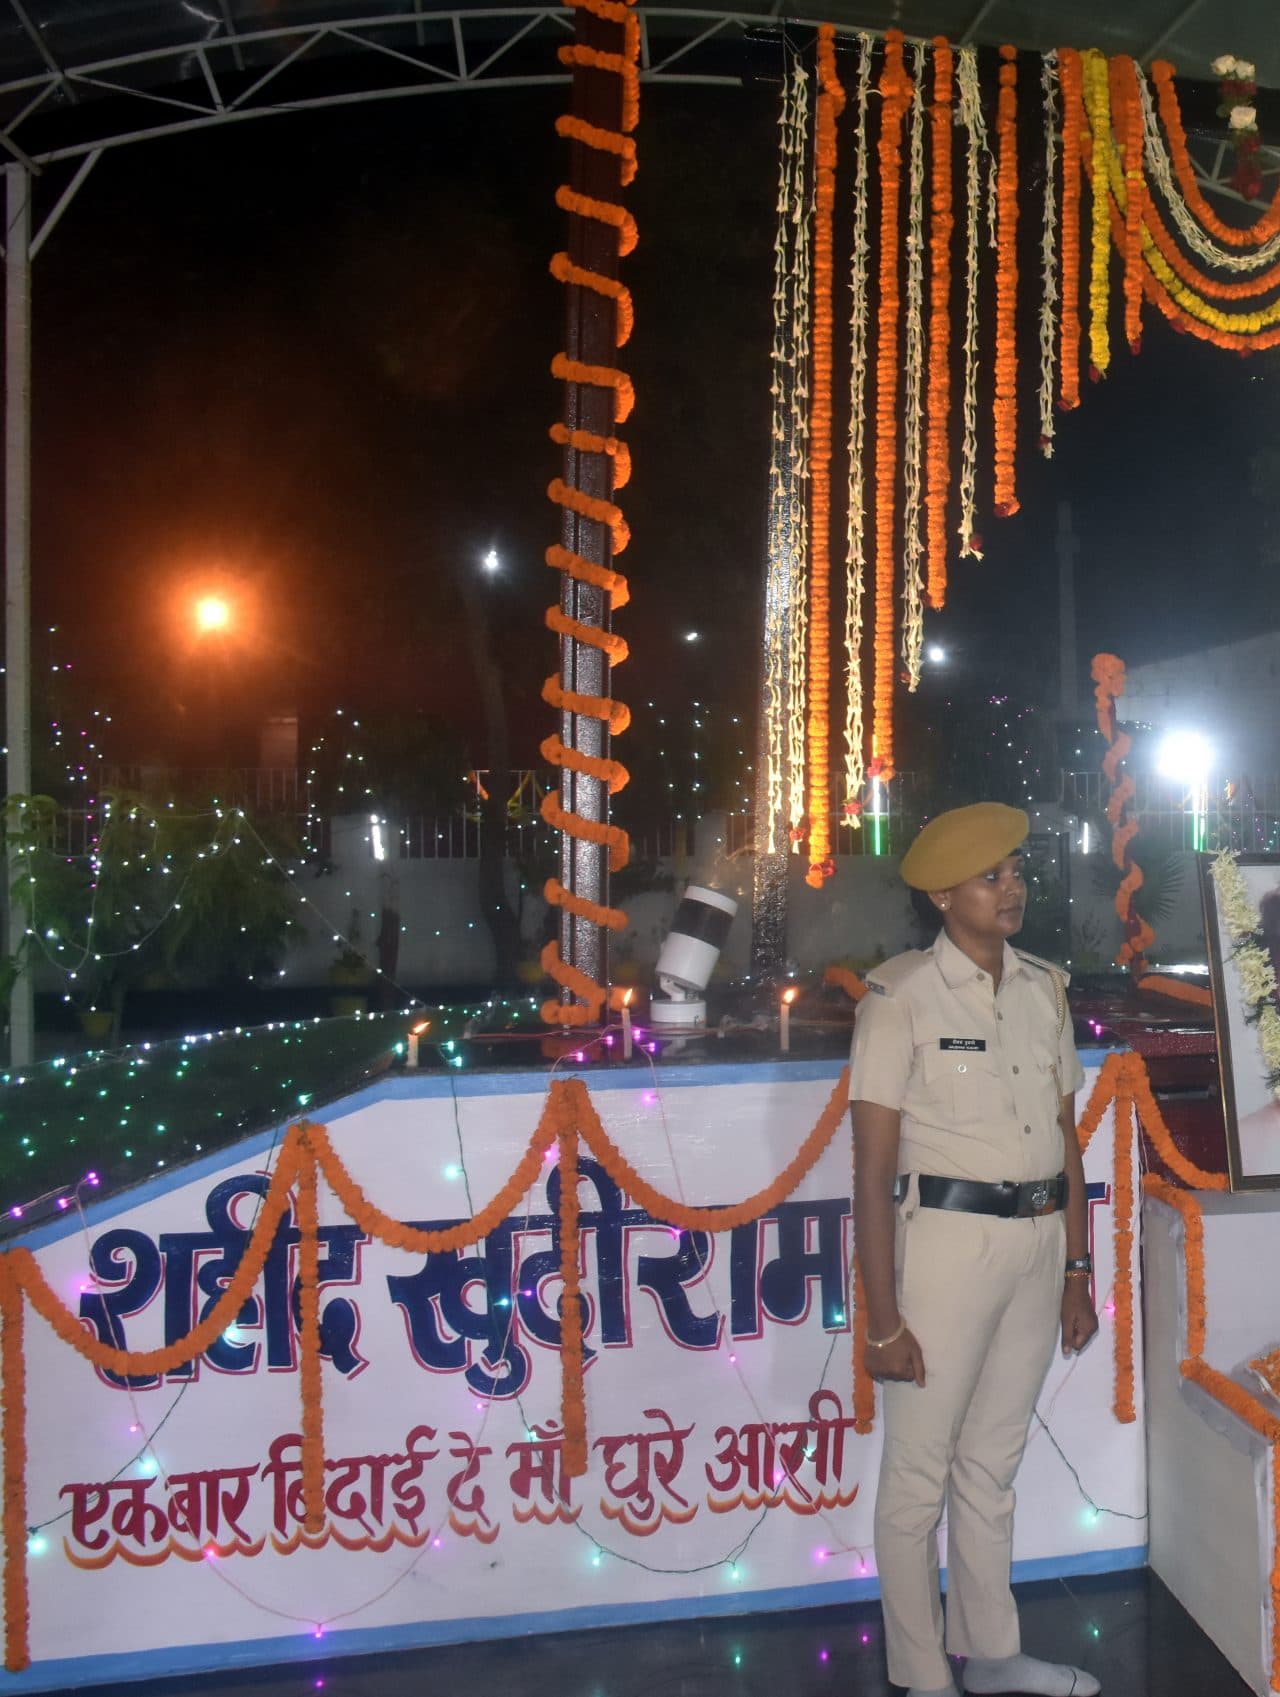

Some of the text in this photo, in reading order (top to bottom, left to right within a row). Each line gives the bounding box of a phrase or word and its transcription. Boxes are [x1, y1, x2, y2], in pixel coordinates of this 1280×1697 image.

[79, 1170, 373, 1391] शहीद
[386, 1156, 853, 1401] खुदीराम
[446, 1431, 493, 1528] दे
[505, 1419, 580, 1506] माँ
[592, 1408, 696, 1521] घुरे
[705, 1389, 858, 1504] आसी
